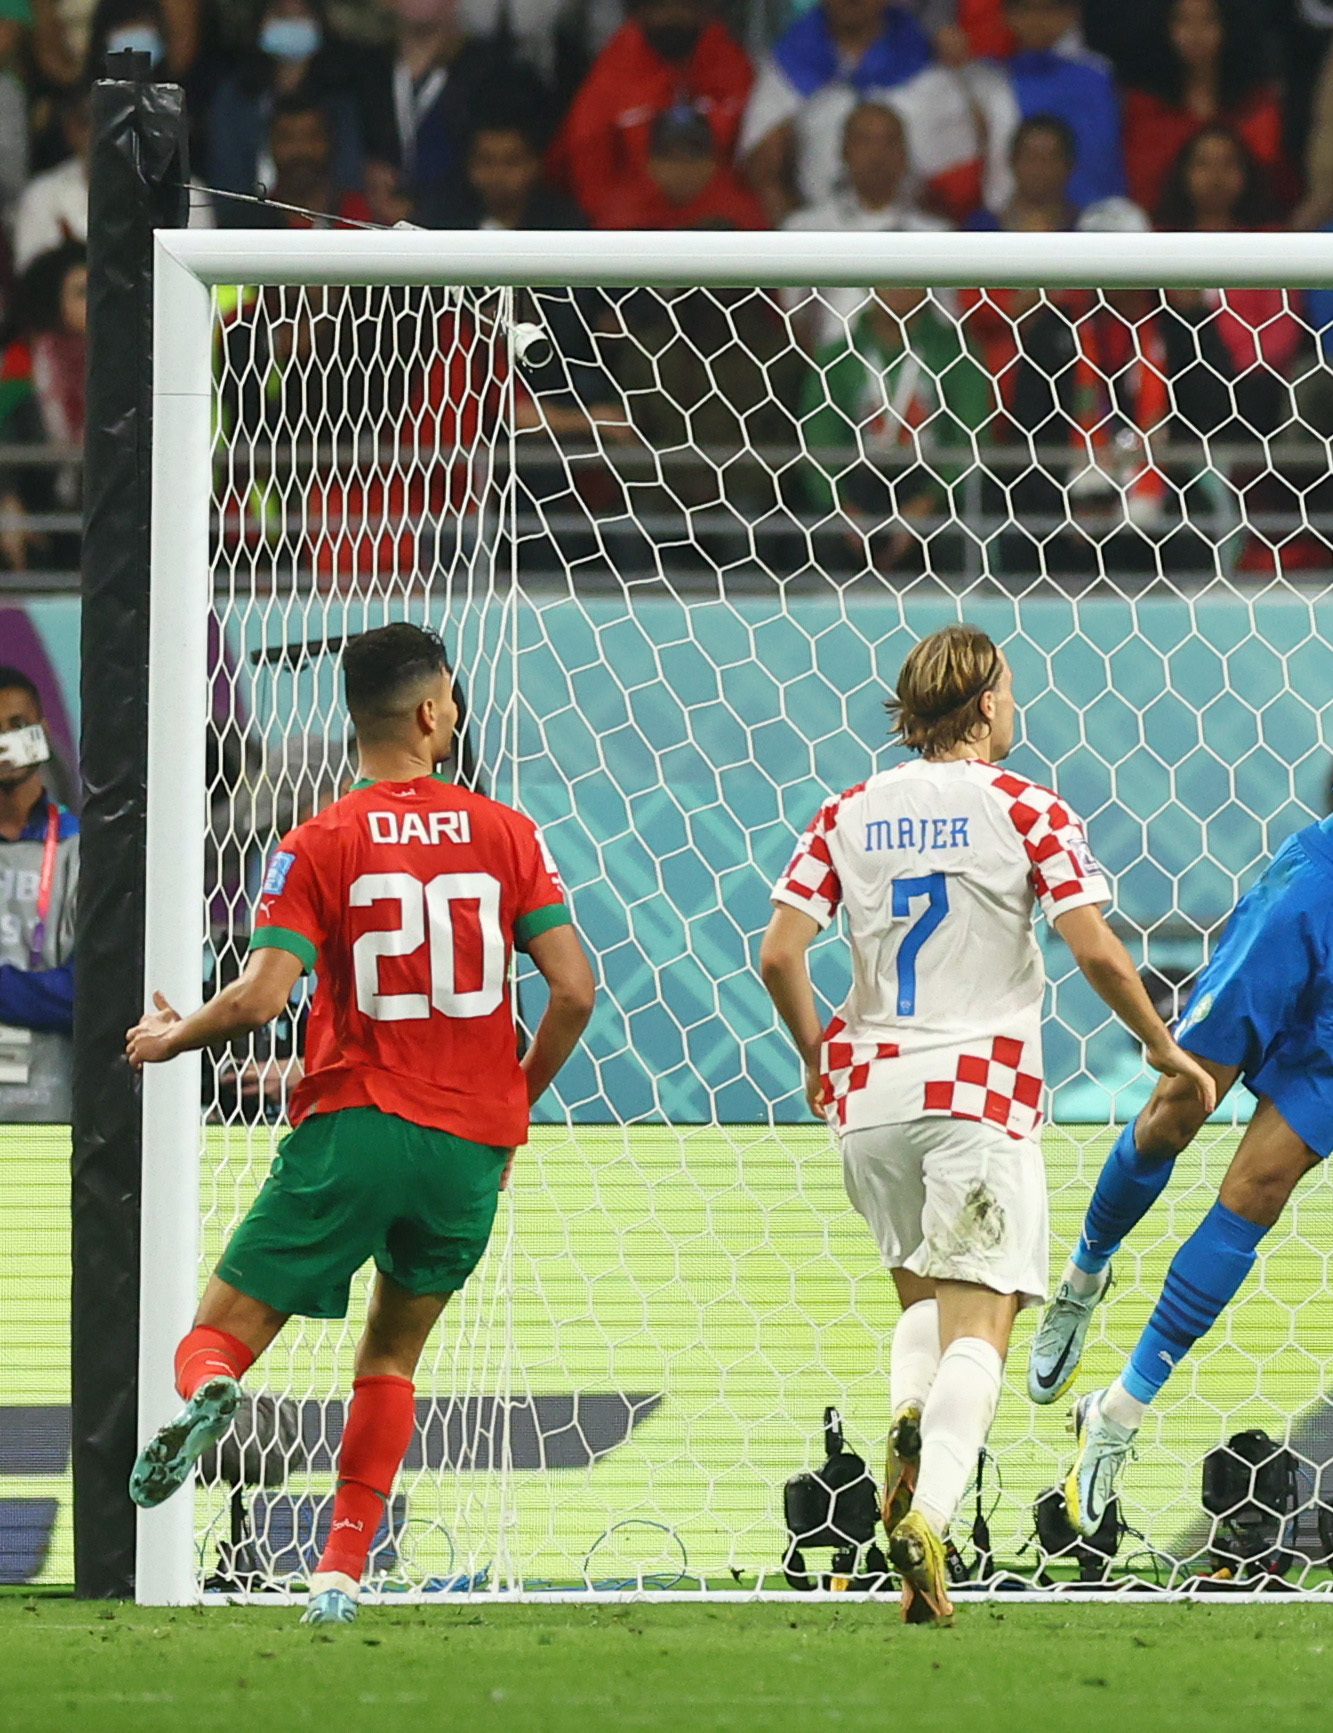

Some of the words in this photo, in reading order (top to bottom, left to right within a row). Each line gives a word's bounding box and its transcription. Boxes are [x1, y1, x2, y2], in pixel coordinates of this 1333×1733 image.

[367, 810, 472, 845] DARI
[865, 817, 970, 854] MAJER
[348, 871, 506, 1022] 20
[890, 872, 950, 1017] 7
